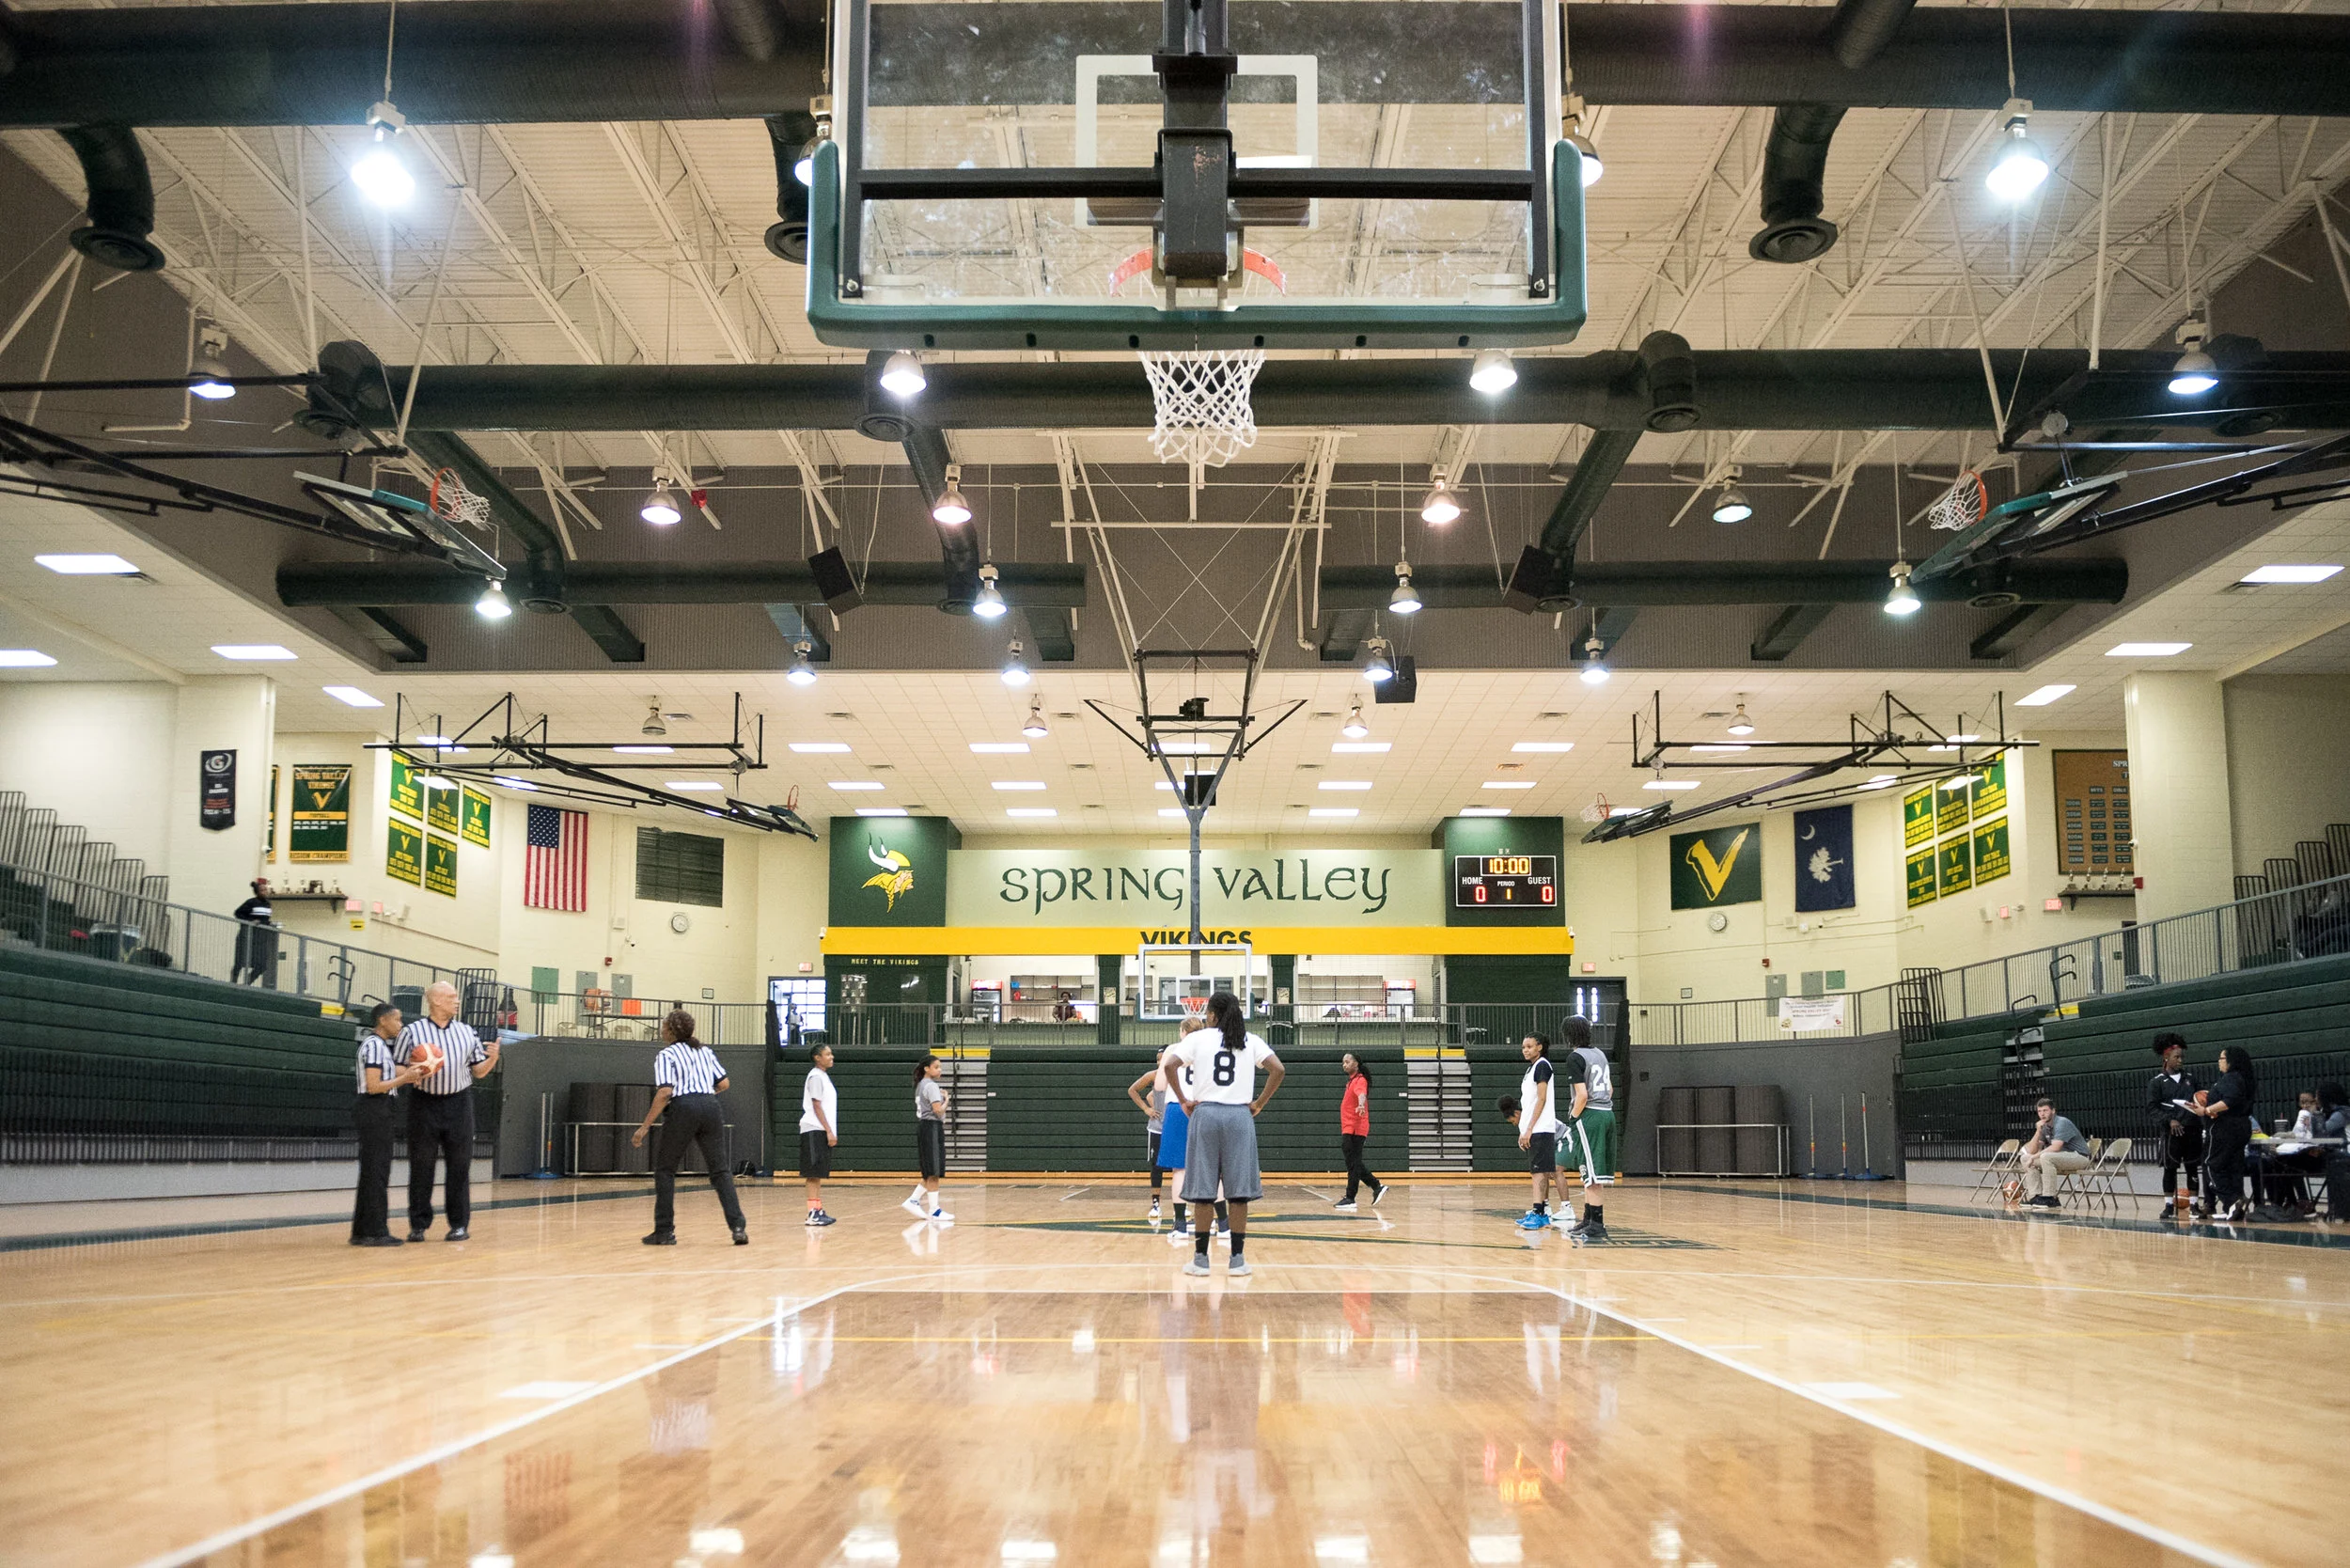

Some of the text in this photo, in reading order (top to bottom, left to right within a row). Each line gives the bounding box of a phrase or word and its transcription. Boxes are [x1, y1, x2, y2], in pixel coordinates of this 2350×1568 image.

[1489, 857, 1529, 874] 10:00
[1462, 876, 1482, 885] HOME
[1528, 876, 1551, 885] GUEST
[999, 868, 1184, 916] SPRING
[1475, 886, 1486, 902] 0
[1506, 888, 1512, 900] 1
[1542, 886, 1553, 902] 0
[1214, 1051, 1236, 1086] 8
[1590, 1064, 1610, 1092] 24
